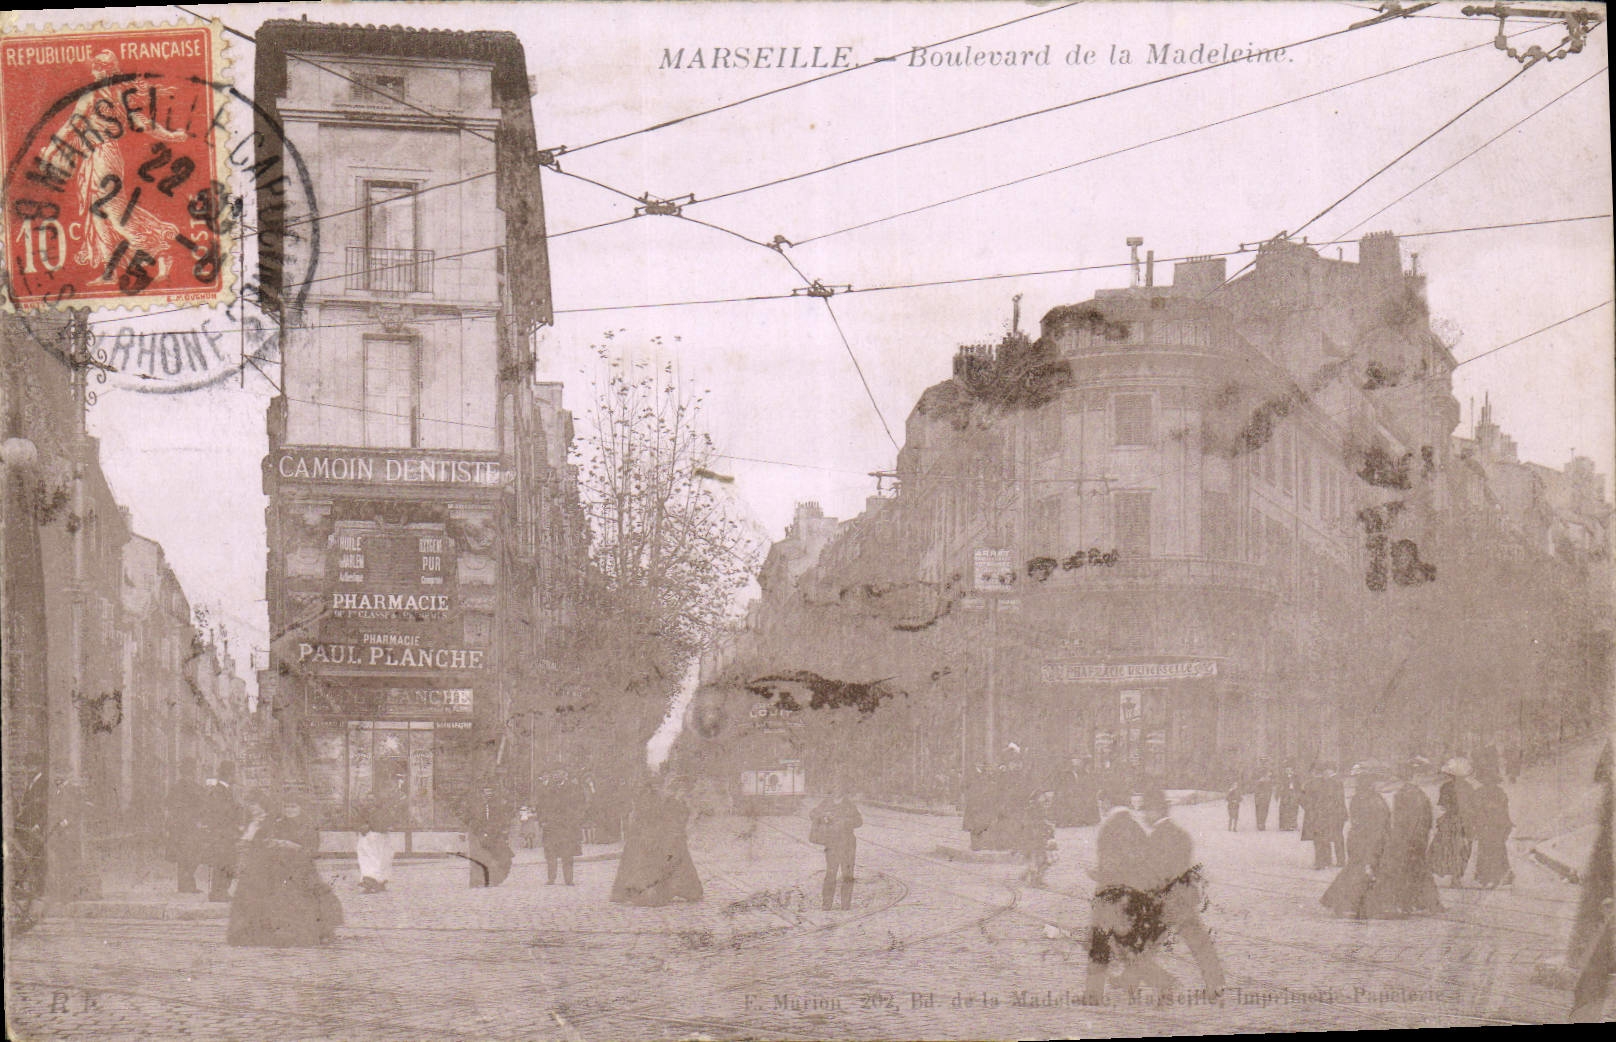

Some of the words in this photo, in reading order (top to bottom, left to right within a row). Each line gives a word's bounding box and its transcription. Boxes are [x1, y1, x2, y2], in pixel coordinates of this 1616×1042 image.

[120, 39, 201, 60] FRANÇAISE
[279, 455, 373, 481] CAMOIN
[386, 458, 500, 485] DENTISTE
[422, 555, 441, 571] PUR
[332, 593, 449, 611] PHARMACIE
[363, 633, 421, 646] PHARMACIE
[369, 647, 484, 669] PLANCHE
